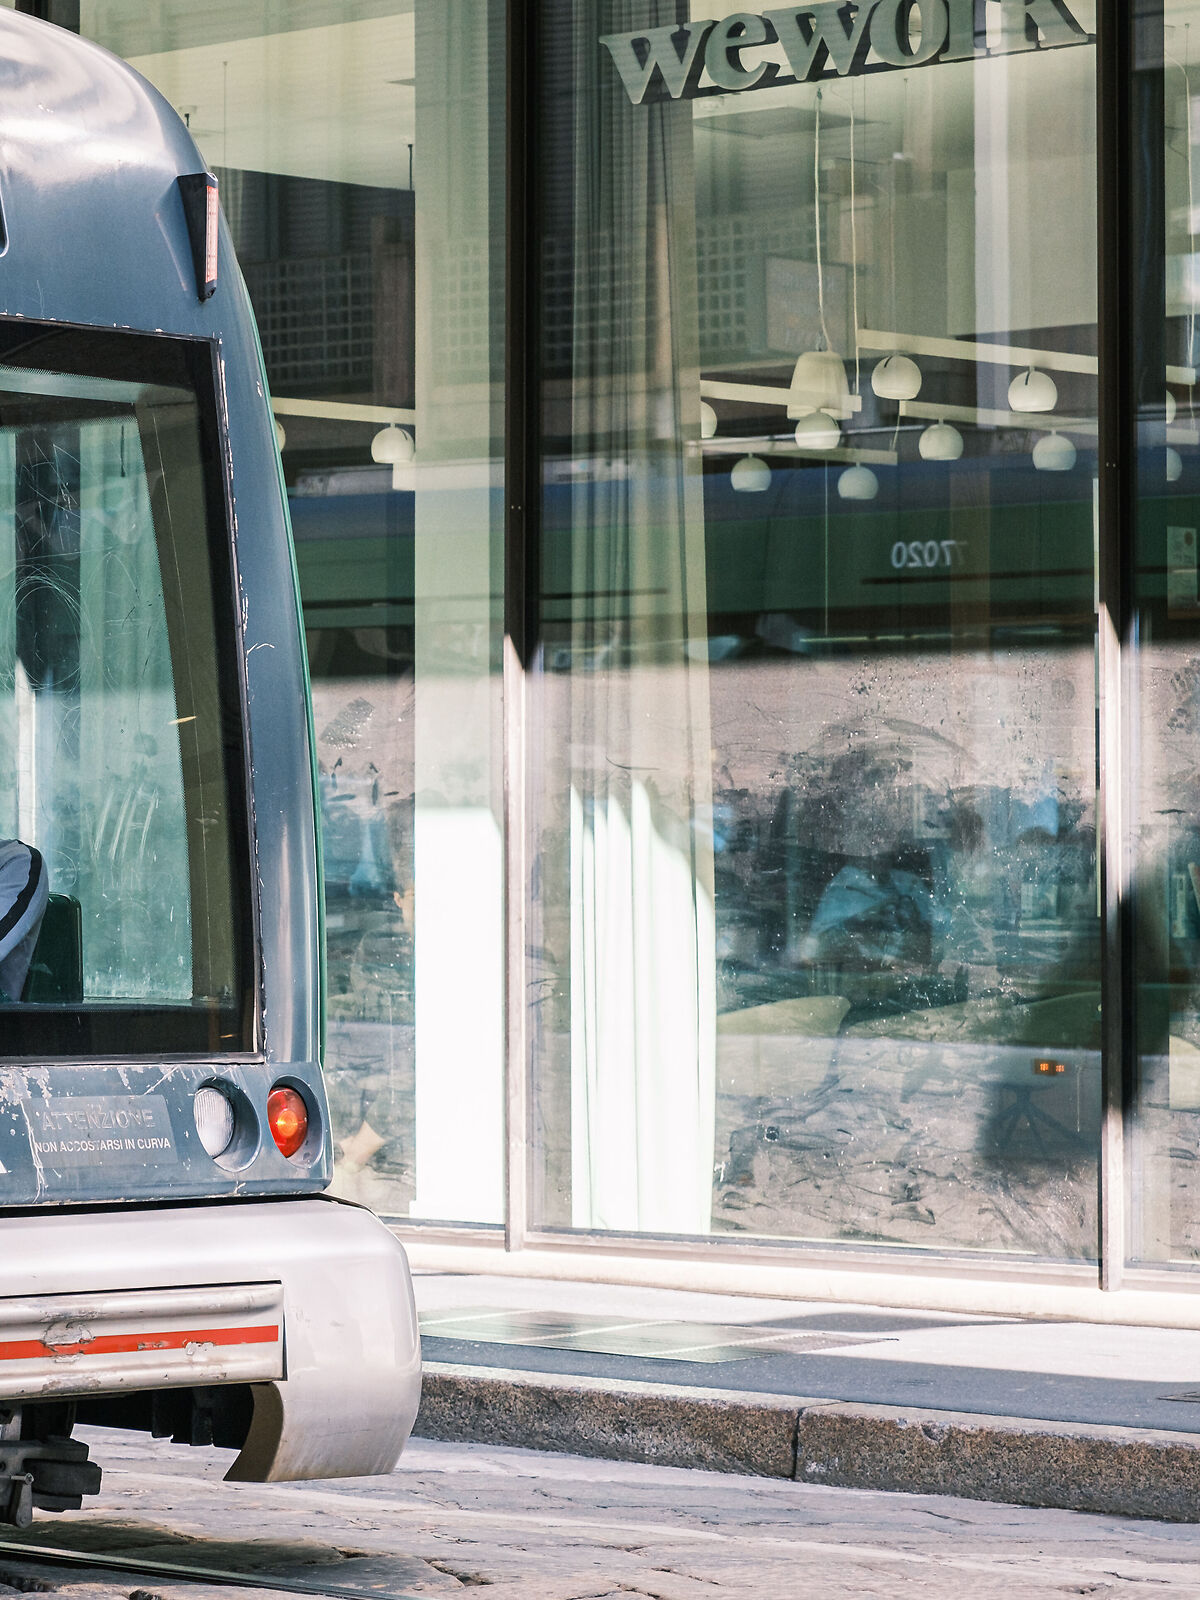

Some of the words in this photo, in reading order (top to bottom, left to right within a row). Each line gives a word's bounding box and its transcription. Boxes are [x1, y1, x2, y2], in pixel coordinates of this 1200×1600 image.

[42, 1110, 156, 1131] ATTENZIONE
[34, 1141, 59, 1153] NON
[125, 1138, 136, 1149] IN
[138, 1137, 171, 1150] CURVA
